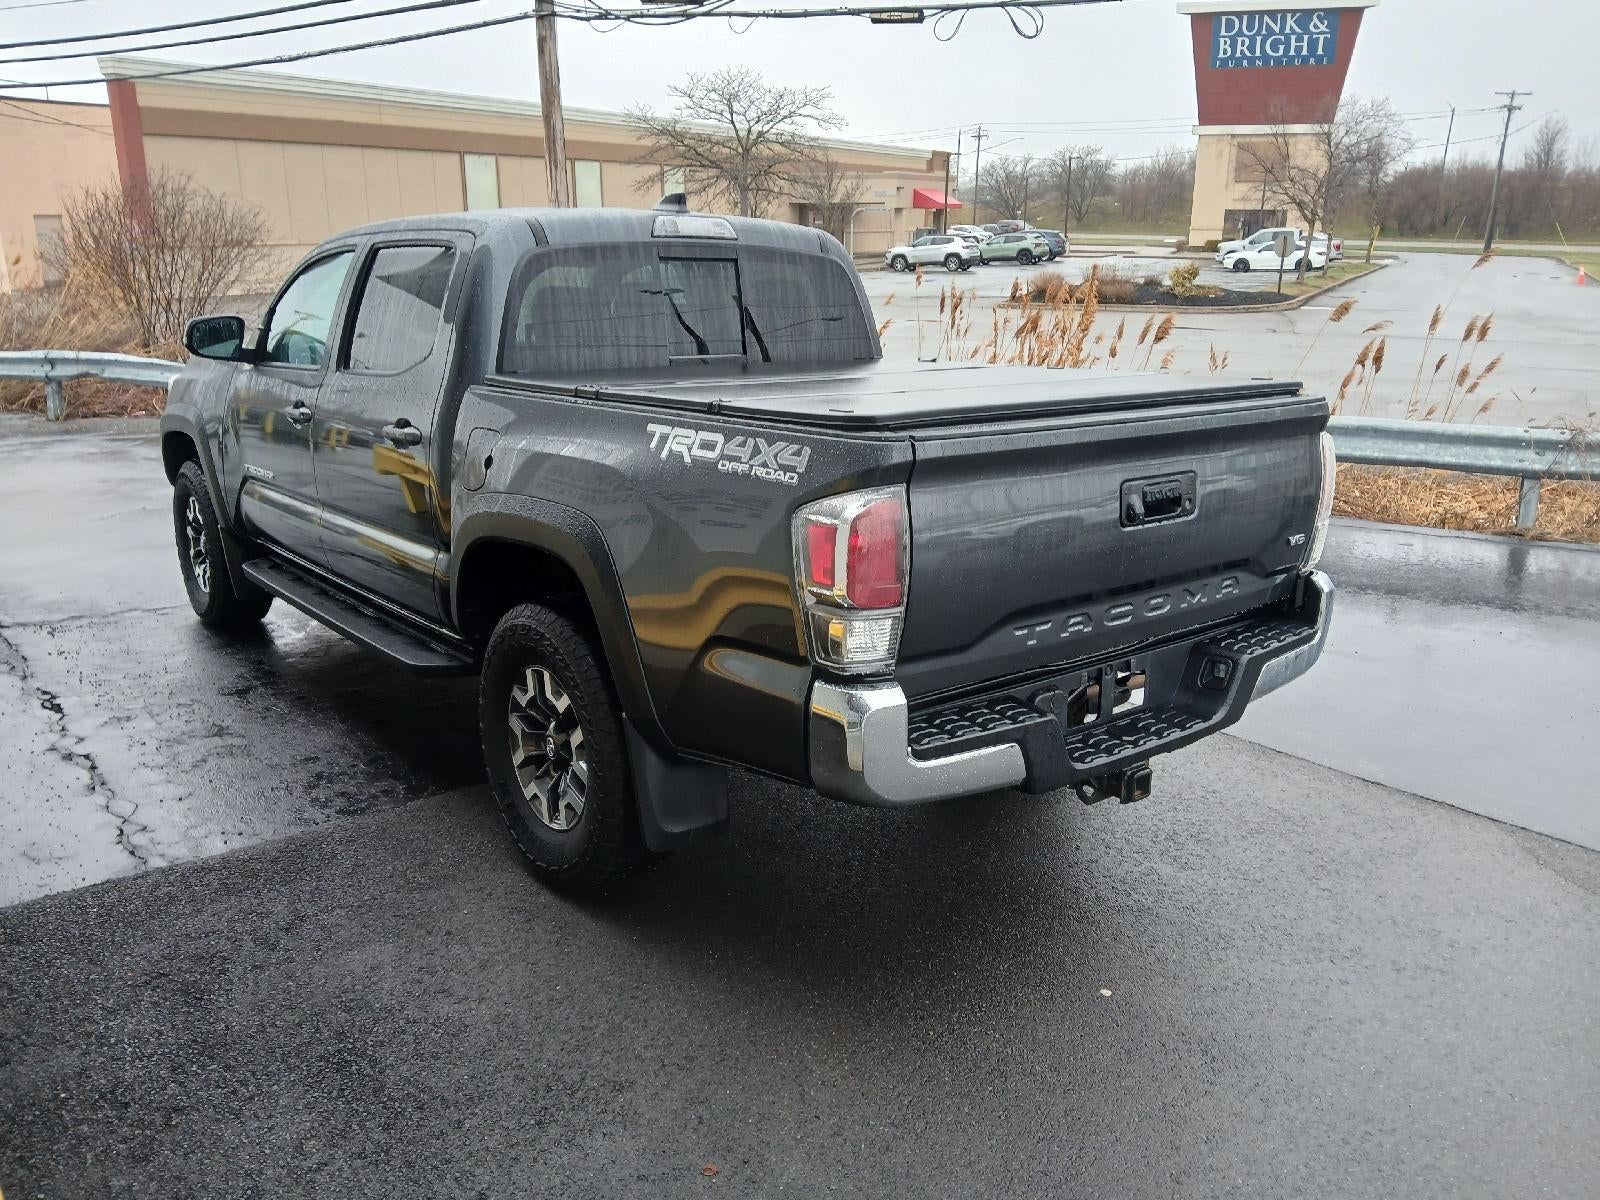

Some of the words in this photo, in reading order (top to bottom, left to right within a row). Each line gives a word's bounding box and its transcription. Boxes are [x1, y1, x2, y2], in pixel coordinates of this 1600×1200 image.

[1219, 13, 1302, 36] DUNK
[1309, 11, 1331, 33] &
[1217, 34, 1331, 58] BRIGHT
[1216, 57, 1329, 68] FURNITURE
[647, 423, 725, 466] TRD
[718, 460, 750, 475] OFF
[751, 466, 800, 486] ROAD
[1288, 533, 1306, 547] V6
[1012, 575, 1241, 647] TACOMA
